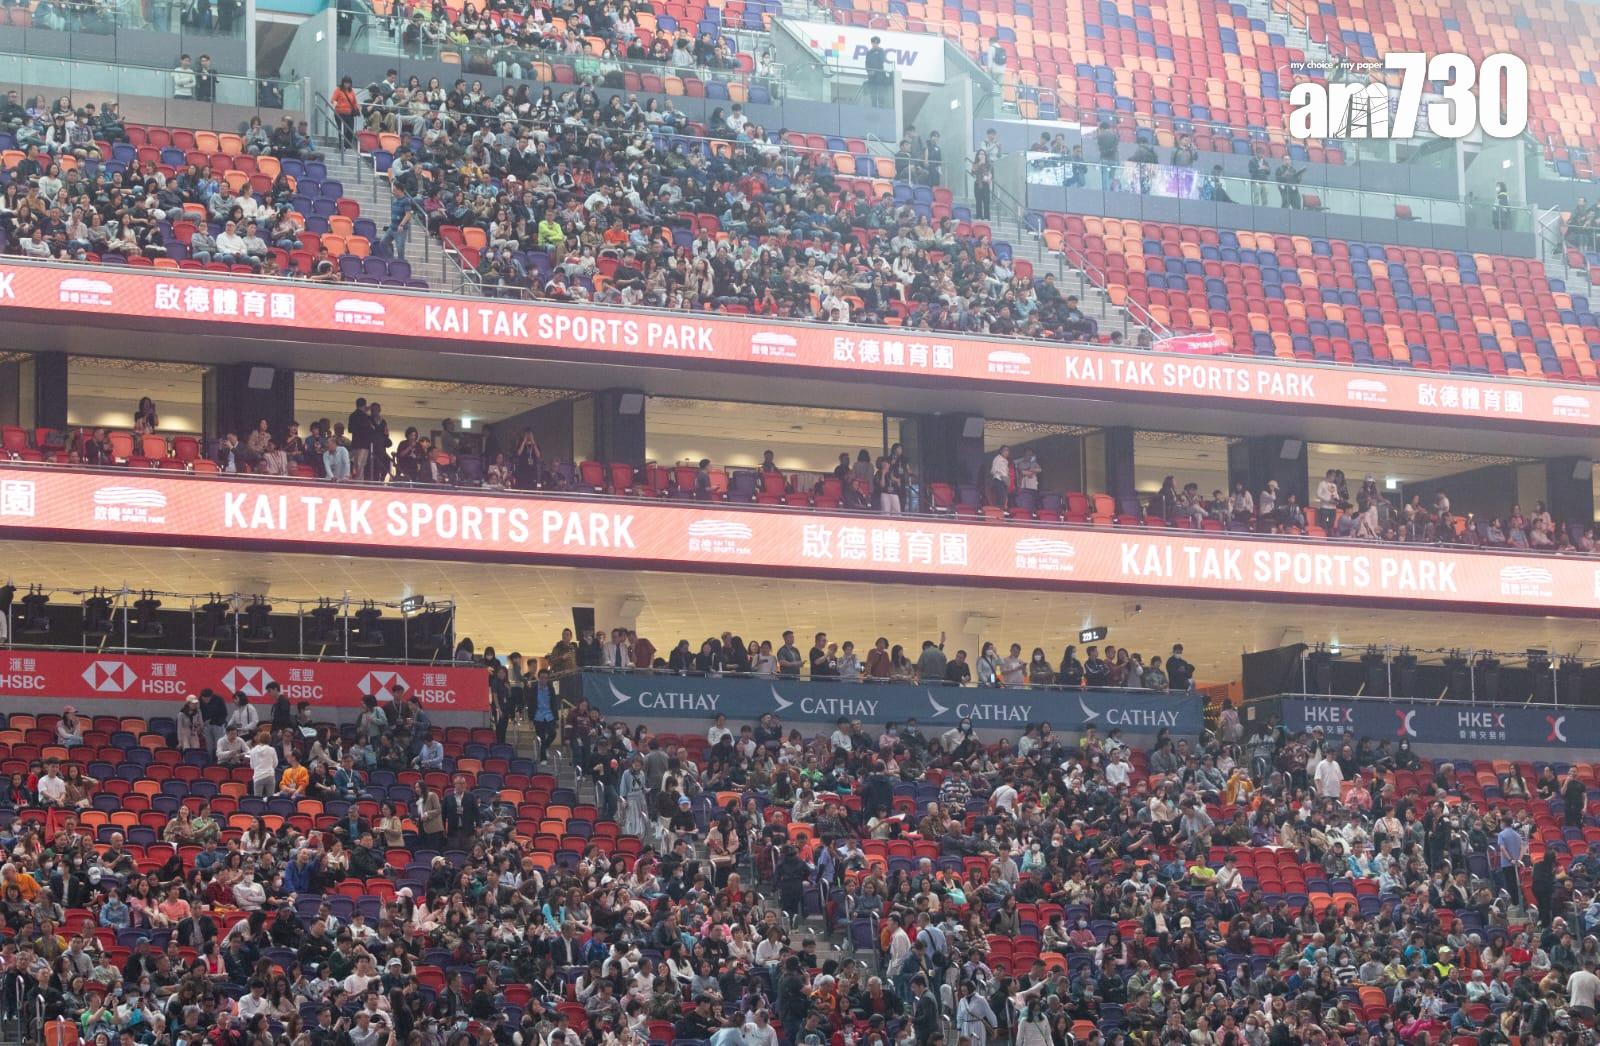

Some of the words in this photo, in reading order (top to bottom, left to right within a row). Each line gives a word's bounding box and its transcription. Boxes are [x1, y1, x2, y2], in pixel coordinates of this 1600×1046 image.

[852, 45, 918, 66] PCW
[154, 283, 296, 320] 啟德體育園
[424, 305, 469, 333] KAI
[478, 309, 529, 338] TAK
[537, 313, 639, 346] SPORTS
[647, 322, 714, 351] PARK
[832, 336, 954, 370] 啟德體育園
[1065, 355, 1104, 382] KAI
[1110, 359, 1155, 386] TAK
[1163, 363, 1250, 392] SPORTS
[1257, 371, 1315, 397] PARK
[0, 480, 35, 517] 園
[224, 492, 287, 530] KAI
[300, 496, 373, 535] TAK
[386, 500, 529, 543] SPORTS
[542, 510, 636, 548] PARK
[802, 524, 968, 566] 啟德體育園
[1121, 543, 1173, 577] KAI
[1183, 546, 1242, 581] TAK
[1254, 550, 1371, 587] SPORTS
[1381, 558, 1457, 592] PARK
[0, 674, 46, 690] HSBC
[141, 680, 187, 694] HSBC
[279, 684, 323, 699] HSBC
[414, 689, 456, 703] HSBC
[638, 691, 720, 710] CATHAY
[800, 697, 879, 716] CATHAY
[956, 704, 1032, 721] CATHAY
[1304, 705, 1353, 722] HKEX
[1106, 708, 1179, 726] CATHAY
[1457, 711, 1505, 728] HKEX
